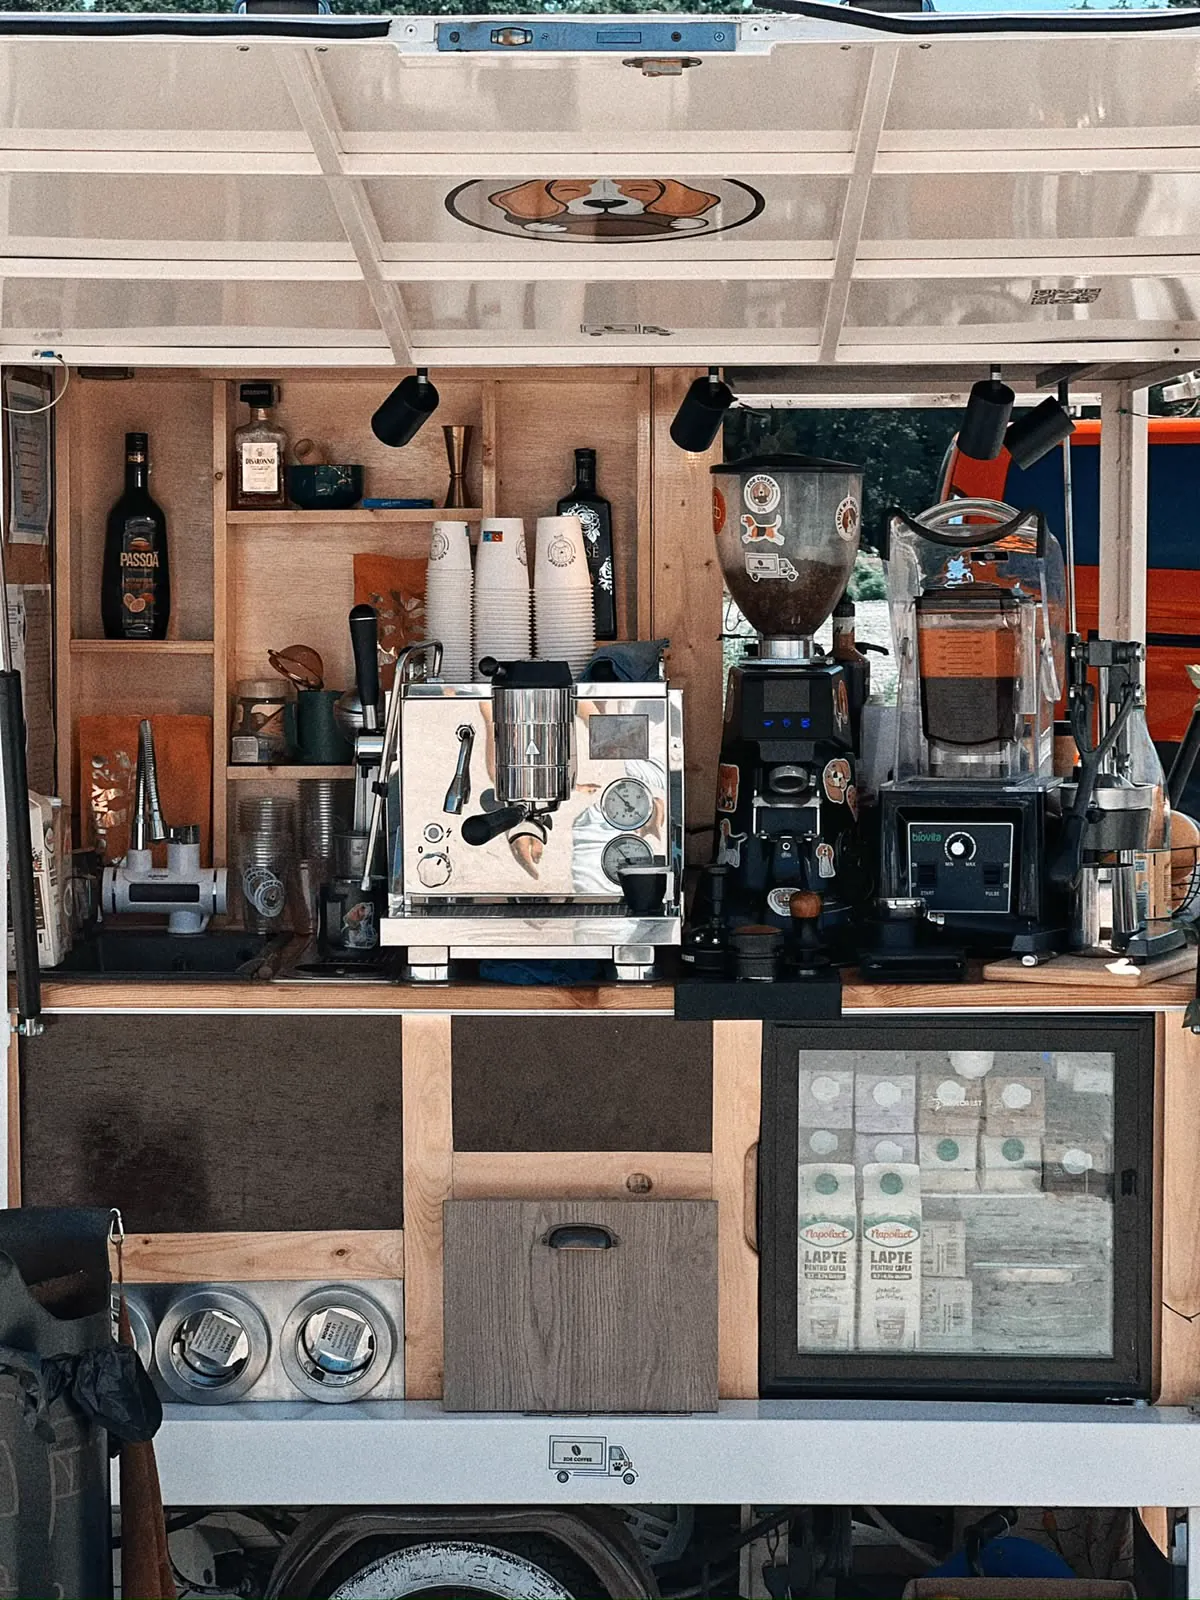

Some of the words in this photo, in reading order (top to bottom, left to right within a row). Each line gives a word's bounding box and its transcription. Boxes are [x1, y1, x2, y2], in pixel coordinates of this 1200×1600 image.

[245, 458, 276, 466] DISARONNO
[912, 831, 942, 842] biovita
[805, 1228, 849, 1240] Napolact
[871, 1228, 914, 1240] Napolact
[804, 1250, 847, 1264] LAPTE
[870, 1250, 913, 1264] LAPTE
